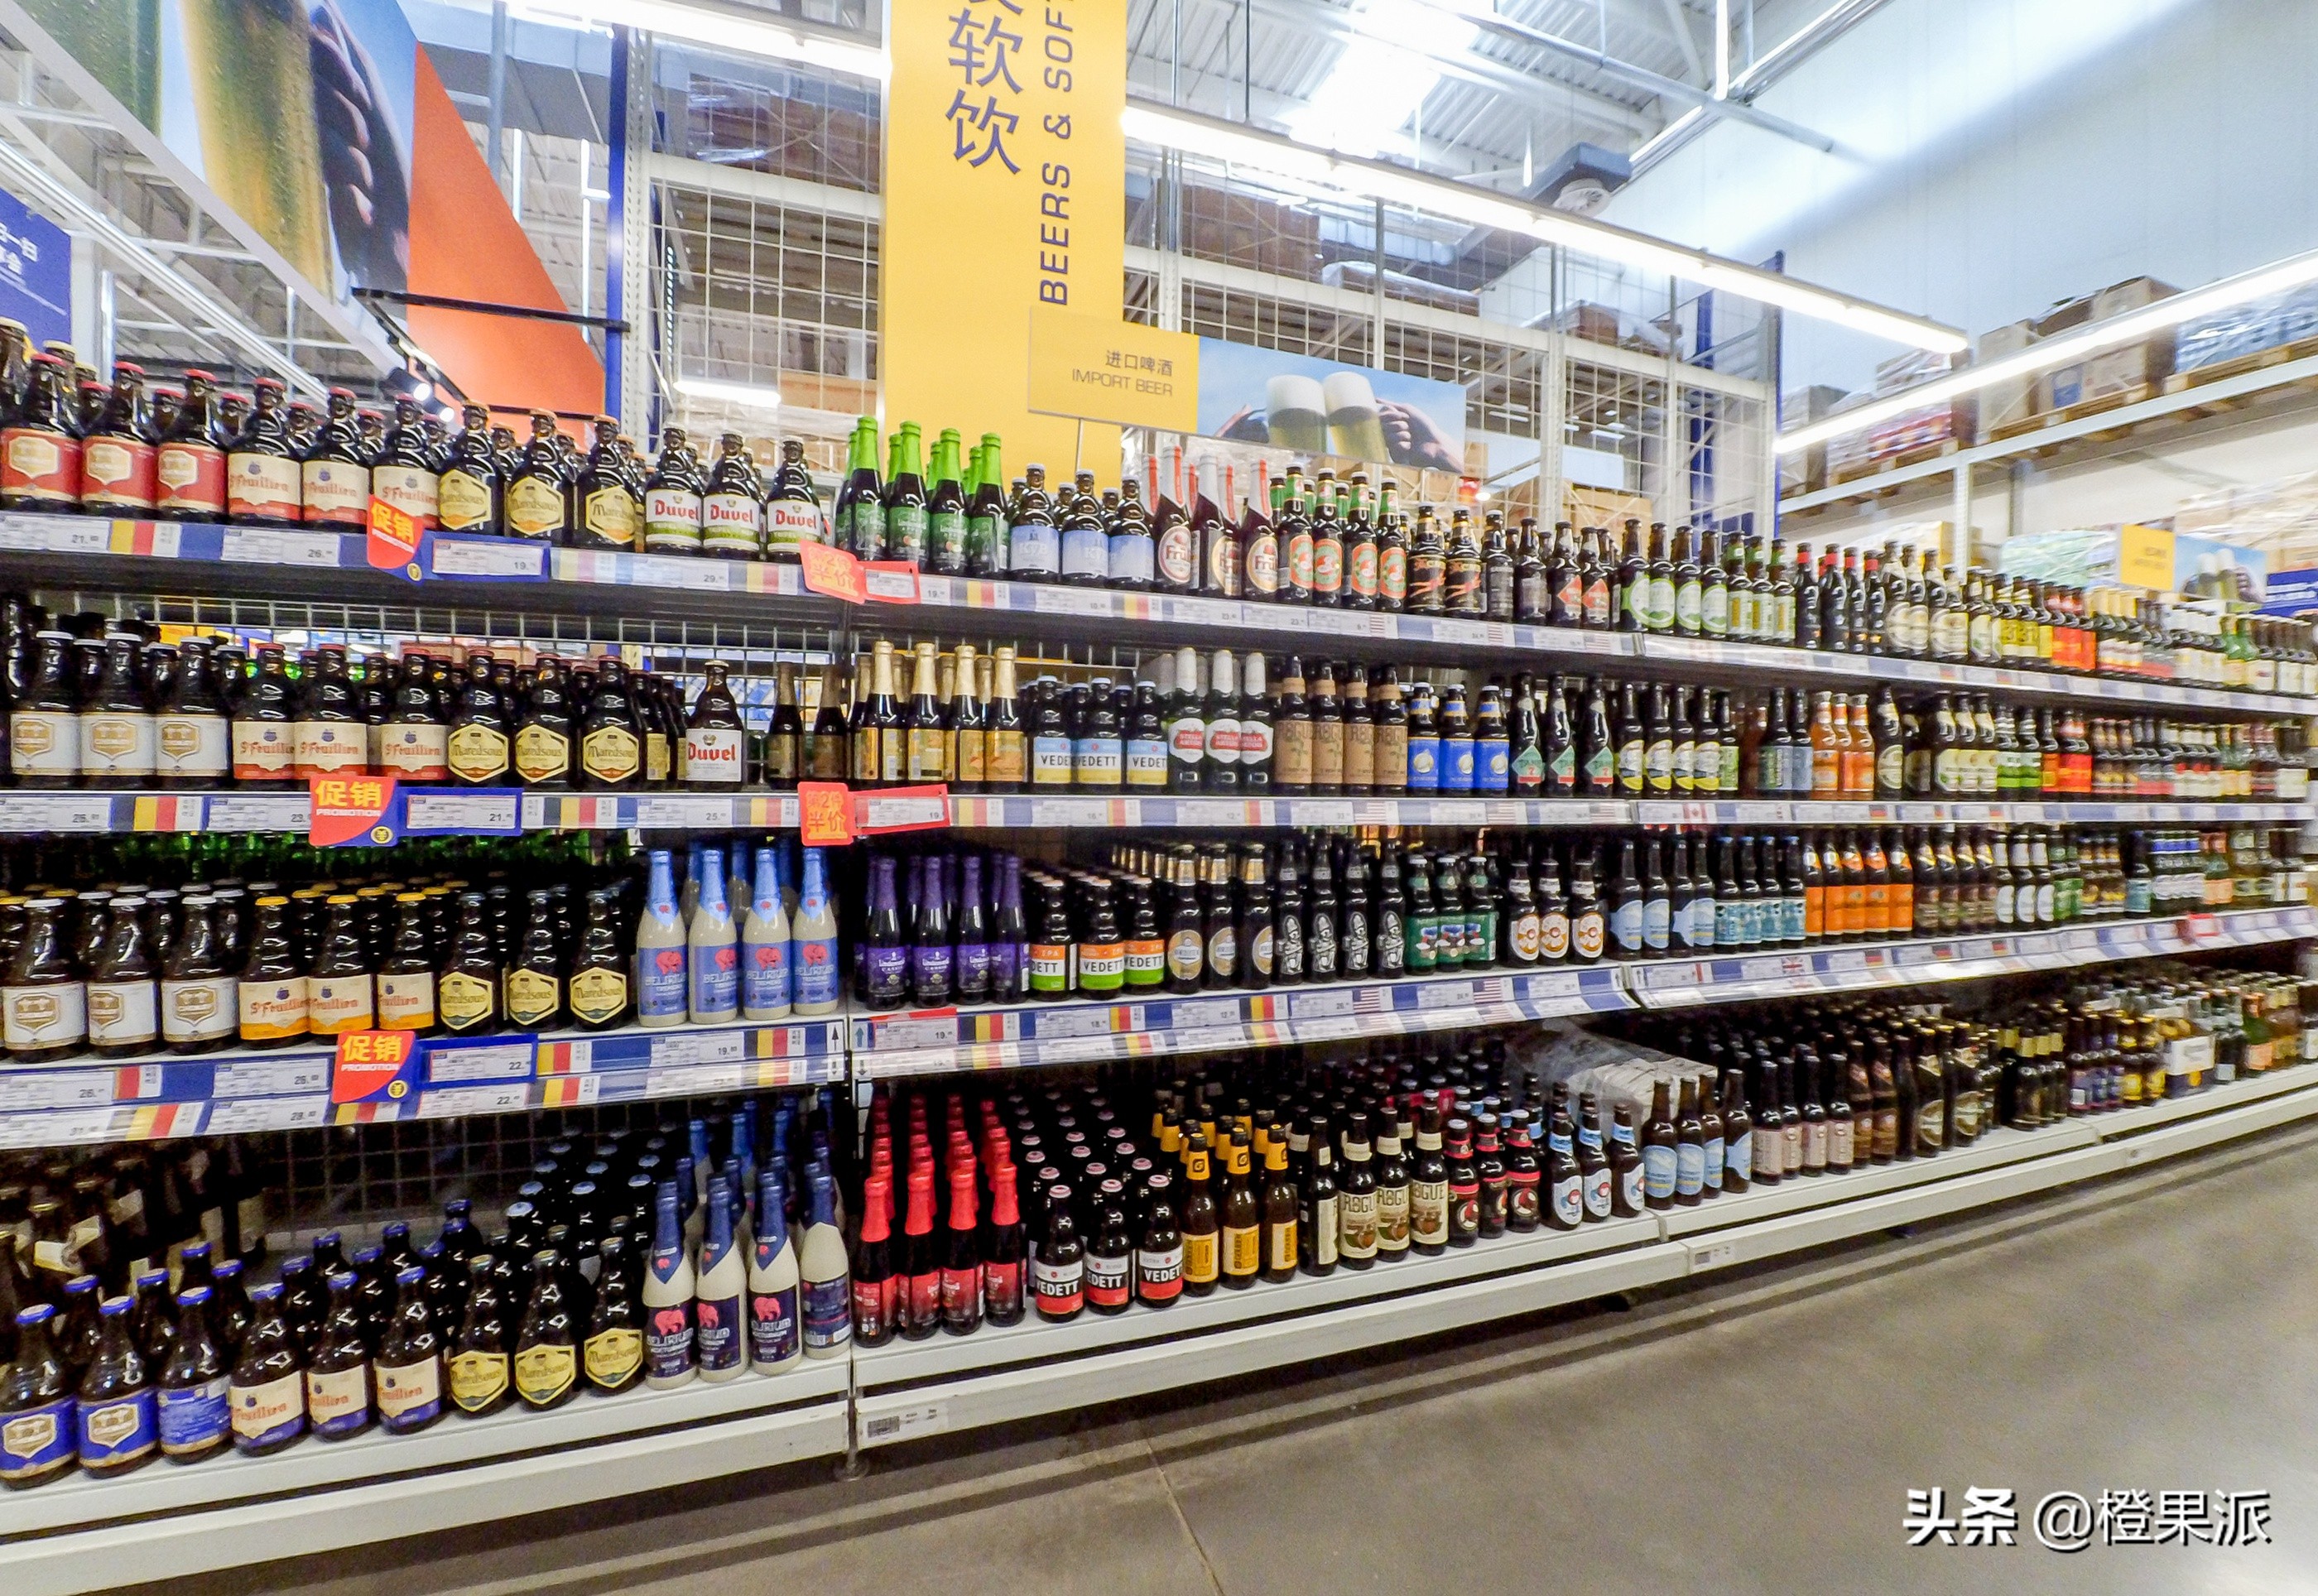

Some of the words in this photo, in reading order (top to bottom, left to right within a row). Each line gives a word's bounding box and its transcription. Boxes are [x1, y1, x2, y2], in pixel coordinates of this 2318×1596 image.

[1044, 0, 1075, 93] SOF
[945, 0, 1023, 175] 软饮
[1043, 114, 1071, 140] &
[1040, 163, 1070, 305] BEERS
[1105, 349, 1173, 377] 进口啤酒
[1072, 368, 1131, 390] IMPORT
[1136, 378, 1173, 397] BEER
[655, 499, 700, 520] Duvel
[710, 504, 754, 524] Duvel
[775, 509, 817, 530] Duvel
[371, 507, 416, 545] 促销
[688, 742, 736, 762] Duvel
[1041, 755, 1070, 767] VEDE
[1133, 757, 1167, 767] VEDET
[315, 780, 382, 808] 促销
[342, 1034, 403, 1063] 促销
[1087, 1273, 1123, 1288] EDETT
[1143, 1267, 1182, 1282] VEDET
